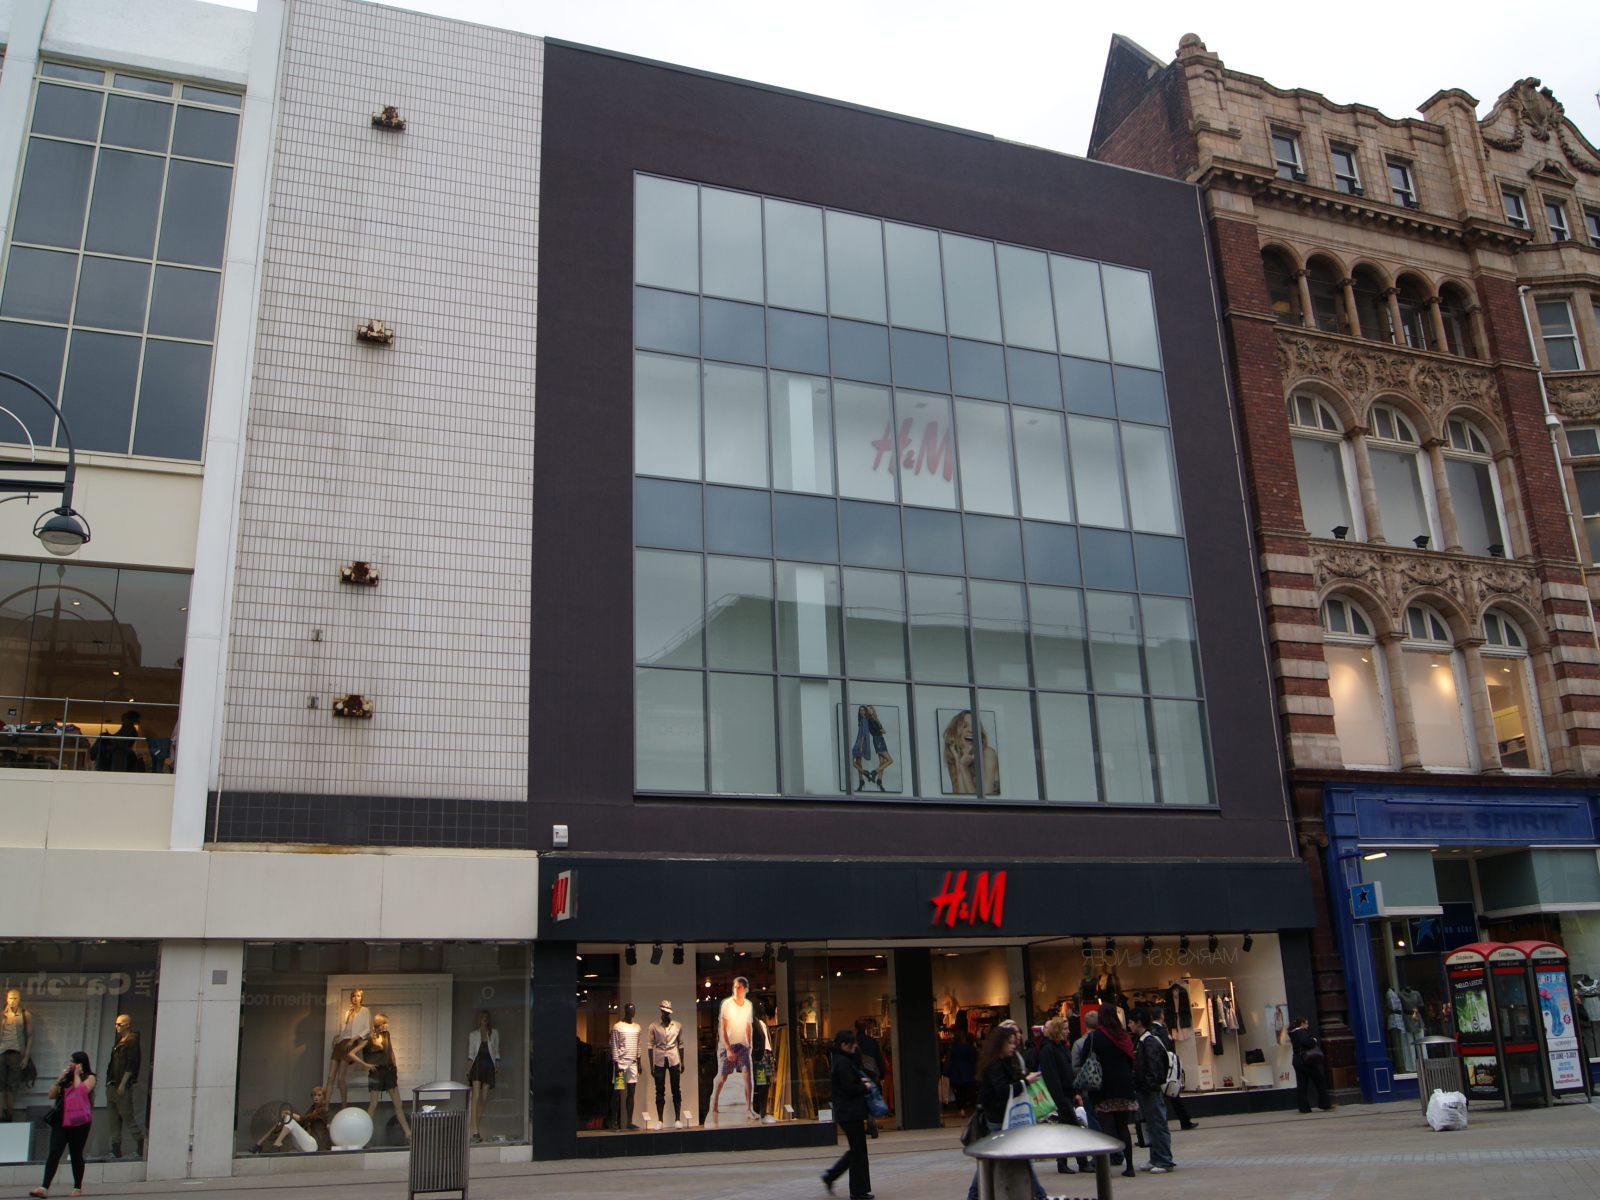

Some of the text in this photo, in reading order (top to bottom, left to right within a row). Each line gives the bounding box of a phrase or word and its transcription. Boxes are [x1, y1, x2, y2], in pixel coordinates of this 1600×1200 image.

[871, 417, 955, 482] H&M
[1389, 811, 1565, 831] FREE SPIRIT
[931, 870, 1007, 928] H&M
